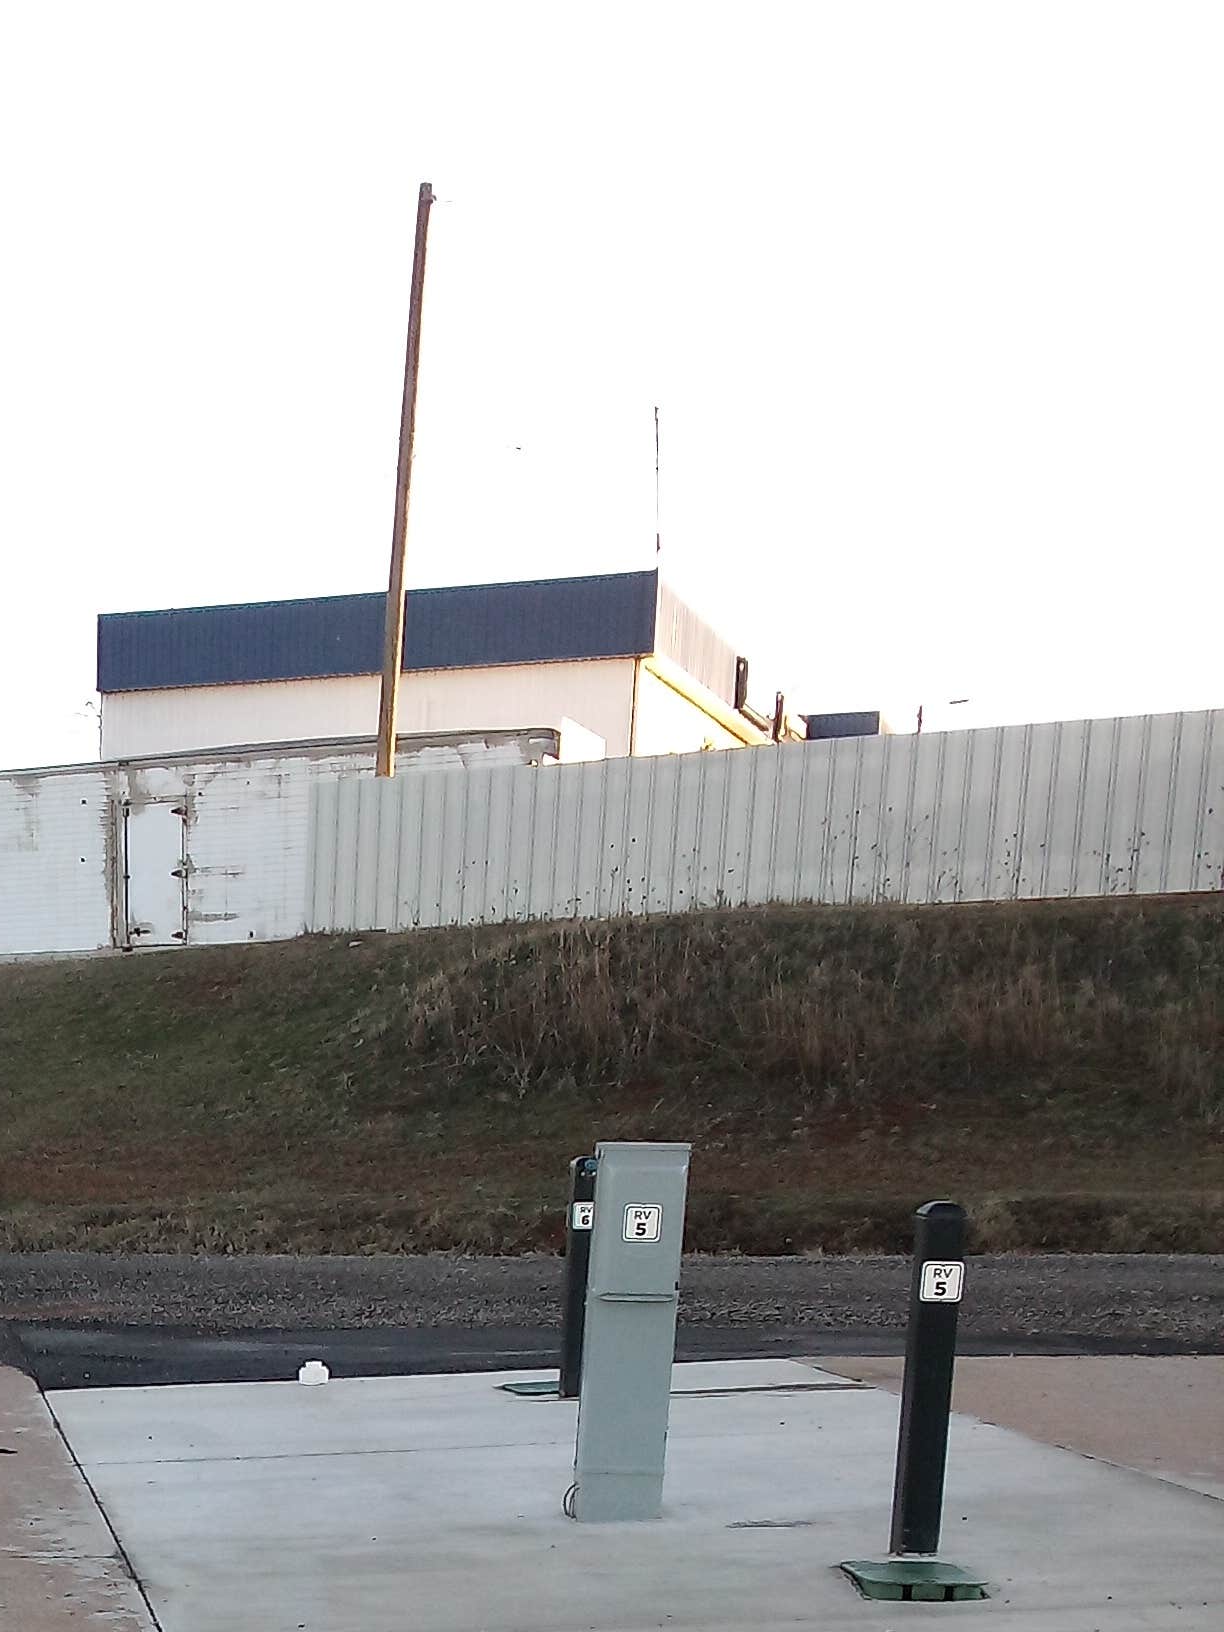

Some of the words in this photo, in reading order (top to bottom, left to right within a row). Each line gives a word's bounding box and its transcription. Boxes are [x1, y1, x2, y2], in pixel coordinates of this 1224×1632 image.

[581, 1215, 590, 1225] 6
[634, 1211, 652, 1220] RV
[635, 1223, 646, 1236] 5
[933, 1268, 953, 1278] RV
[934, 1282, 947, 1296] 5
